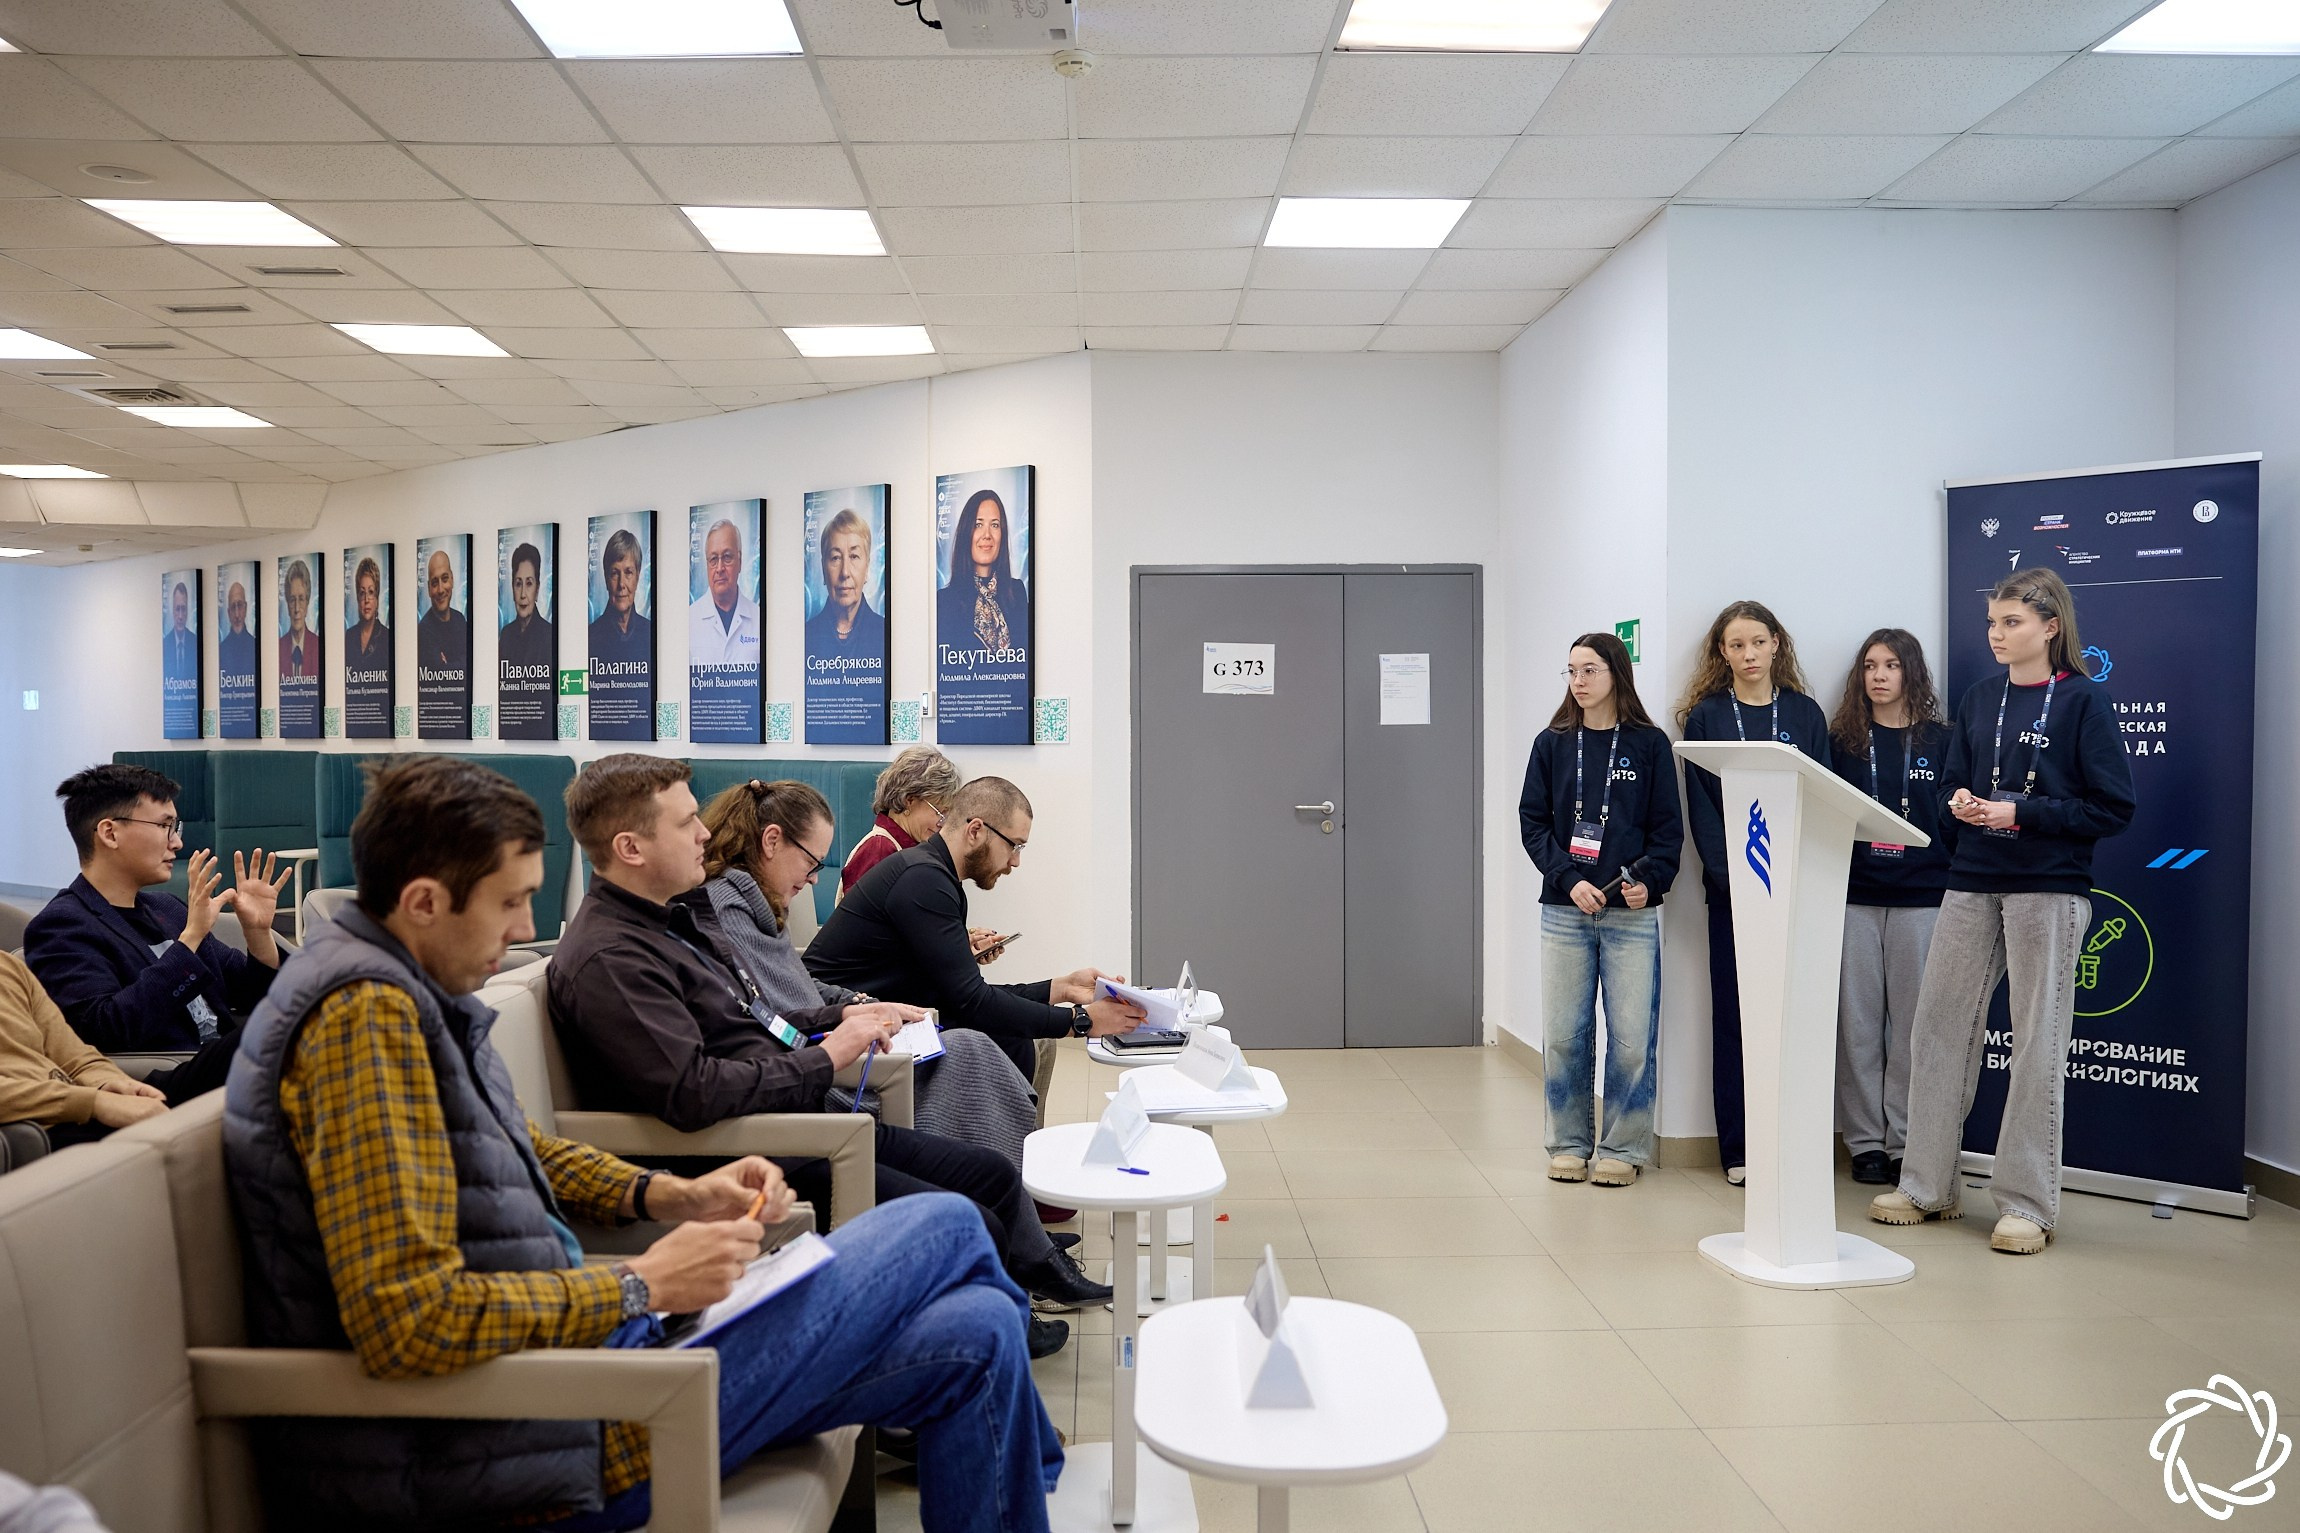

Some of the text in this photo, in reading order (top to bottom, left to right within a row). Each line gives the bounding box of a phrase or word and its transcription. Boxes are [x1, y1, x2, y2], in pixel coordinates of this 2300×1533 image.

[2119, 516, 2152, 524] движение
[939, 644, 1026, 670] Текутьева
[501, 660, 550, 678] Павлова
[590, 658, 648, 675] Палагина
[692, 657, 757, 677] Приходько
[807, 655, 882, 674] Серебрякова
[1214, 660, 1264, 676] G 373
[220, 670, 255, 688] Белкин
[280, 674, 317, 686] Дедюхина
[346, 666, 388, 683] Каленик
[419, 667, 464, 681] Молочков
[807, 675, 882, 686] Людмила Андреевна
[940, 672, 1025, 682] Людмила Александровна
[164, 677, 197, 694] Абрамов
[500, 680, 550, 693] Жанна Петровна
[590, 681, 610, 691] Марина
[691, 676, 758, 690] Юрий Вадимович
[2119, 721, 2166, 732] ЕСКАЯ
[2019, 731, 2050, 748] НТО
[1612, 770, 1637, 780] НТО
[1910, 770, 1934, 780] НТО
